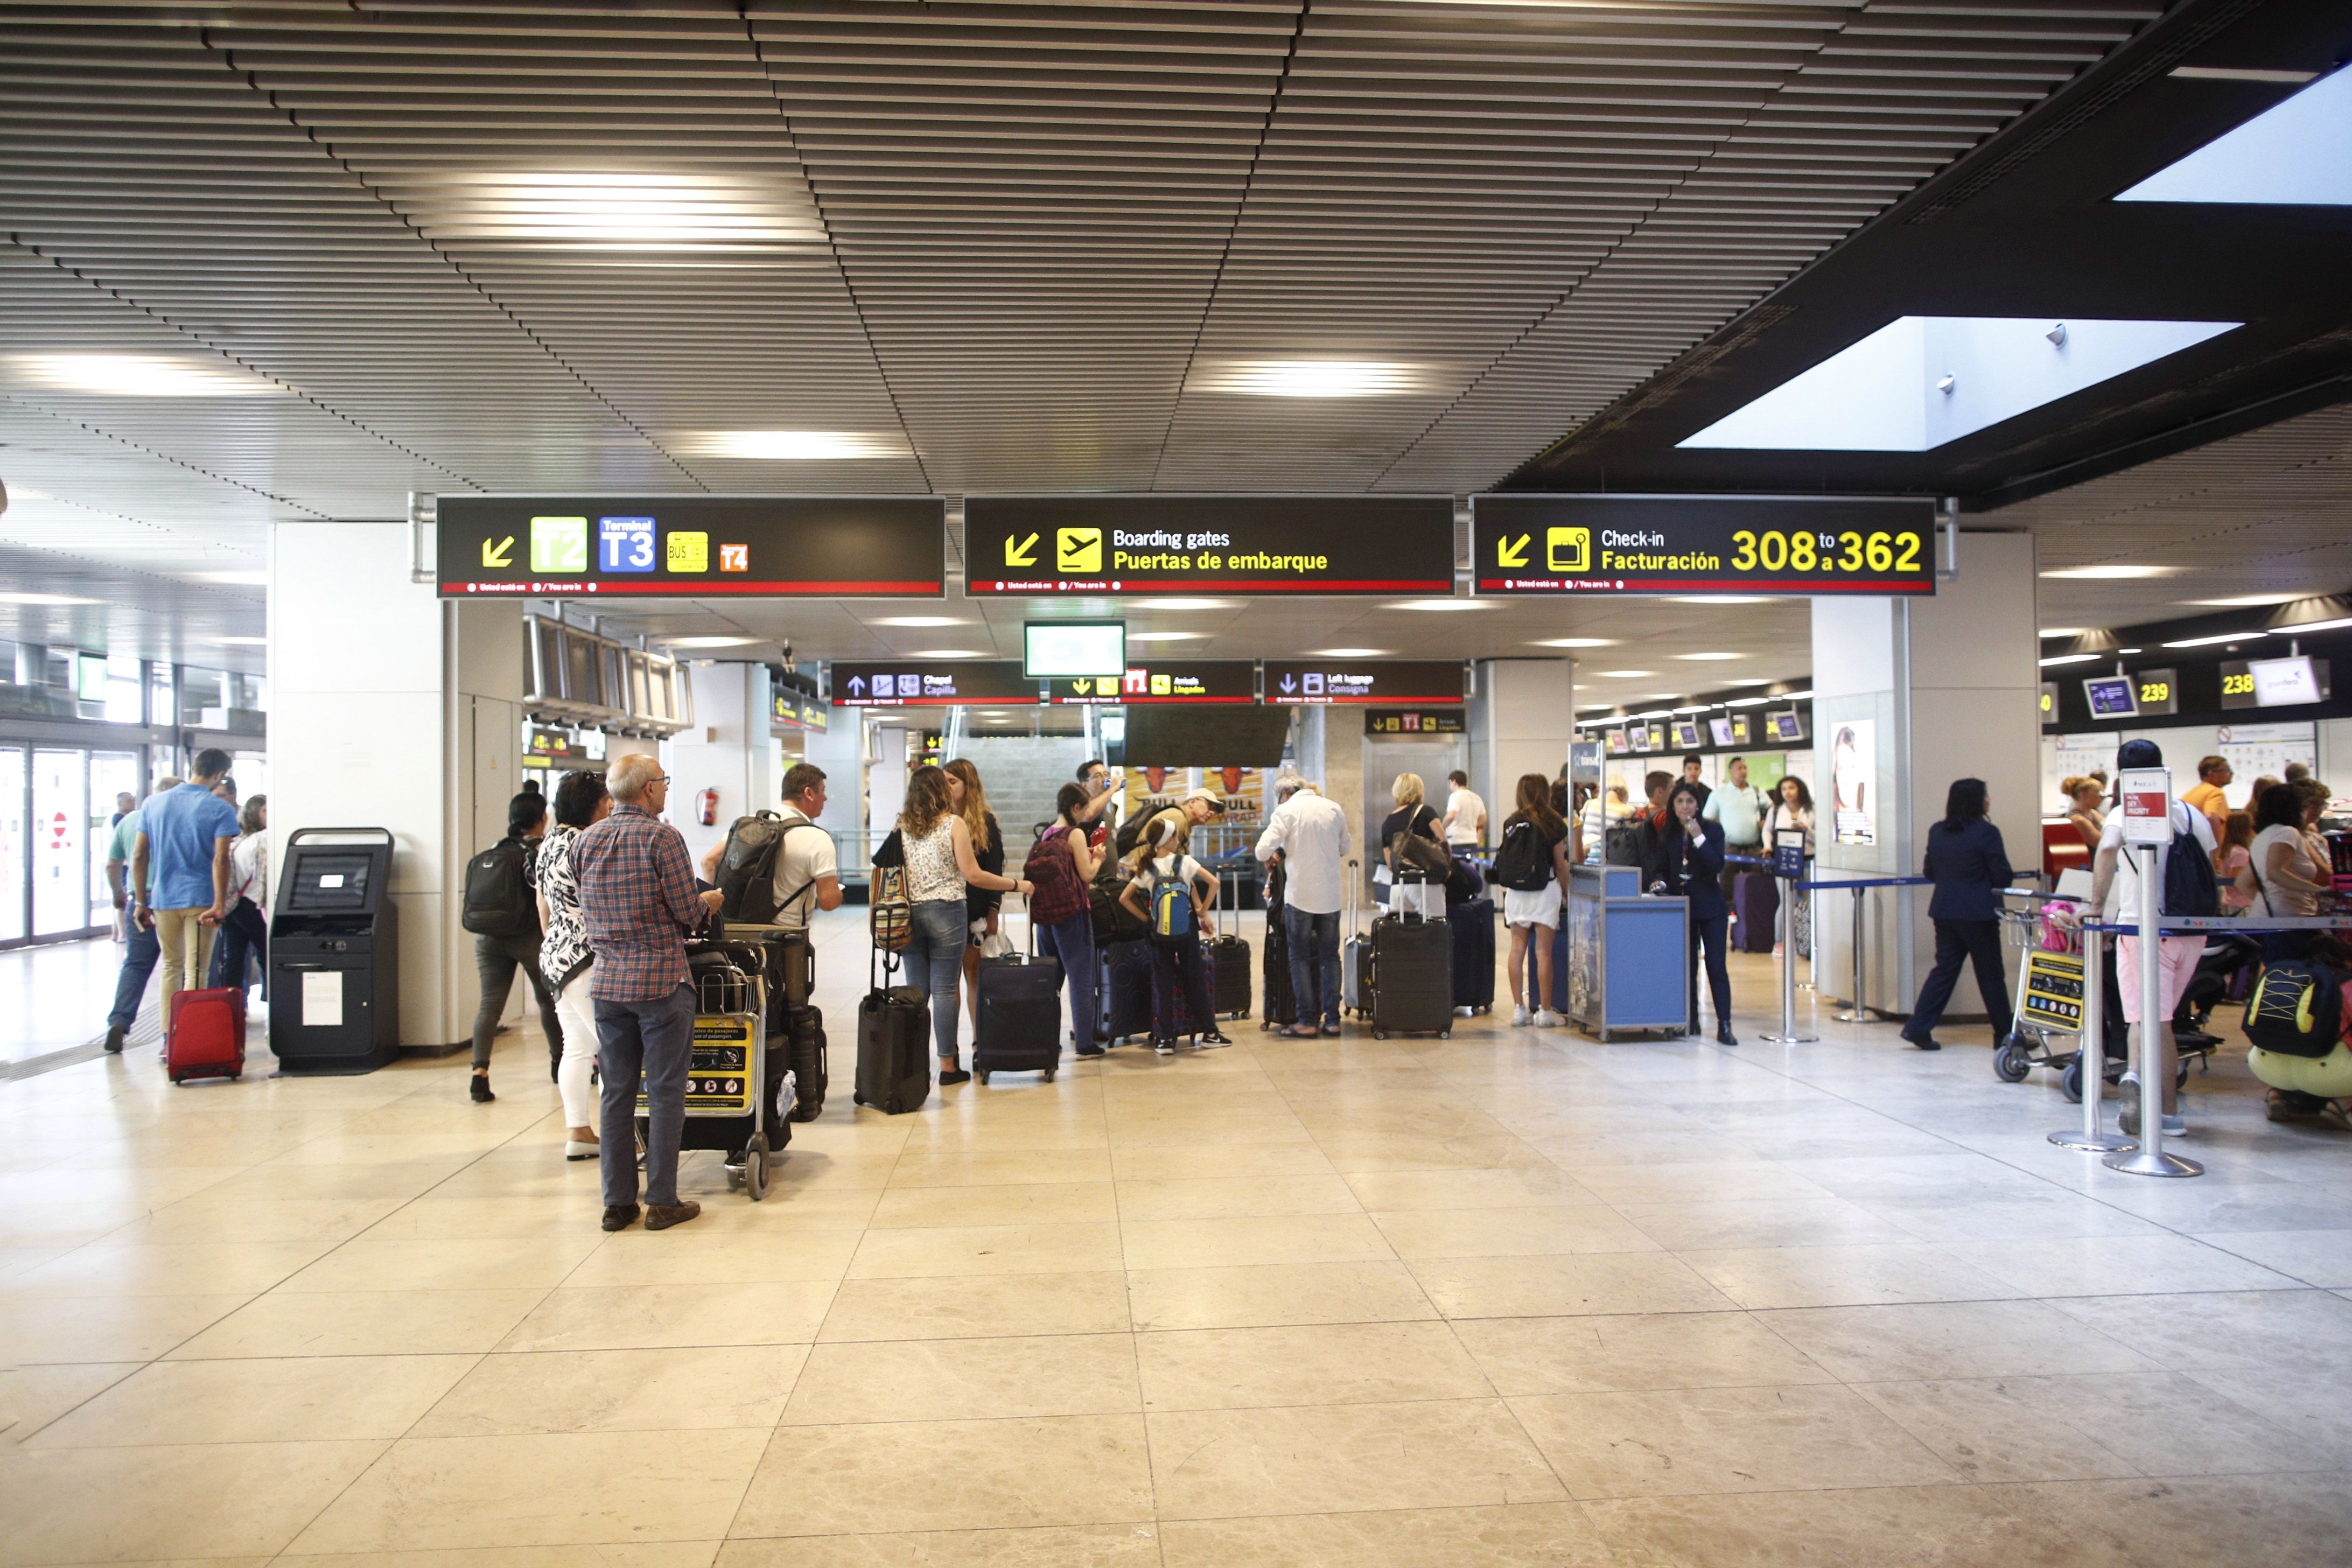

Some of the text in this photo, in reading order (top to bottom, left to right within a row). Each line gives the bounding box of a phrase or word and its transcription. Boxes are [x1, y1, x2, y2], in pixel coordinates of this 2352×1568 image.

[603, 520, 652, 531] Terminal
[1114, 530, 1230, 550] Boarding gates
[1601, 530, 1664, 547] Check-in
[533, 531, 585, 566] T2
[601, 531, 653, 567] T3
[669, 546, 686, 558] BUS
[1731, 530, 1921, 572] 308 to 362
[721, 550, 748, 569] T4
[1114, 551, 1327, 573] Puertas de embarque
[1601, 551, 1720, 570] Facturación
[1821, 556, 1833, 571] a
[479, 583, 500, 591] Usted
[923, 675, 952, 685] Chapel
[1327, 674, 1374, 685] Left luggage
[2223, 674, 2255, 695] 238
[925, 685, 956, 696] Capilla
[1328, 684, 1369, 695] Consigna
[2141, 683, 2169, 702] 239
[1403, 717, 1419, 730] T1
